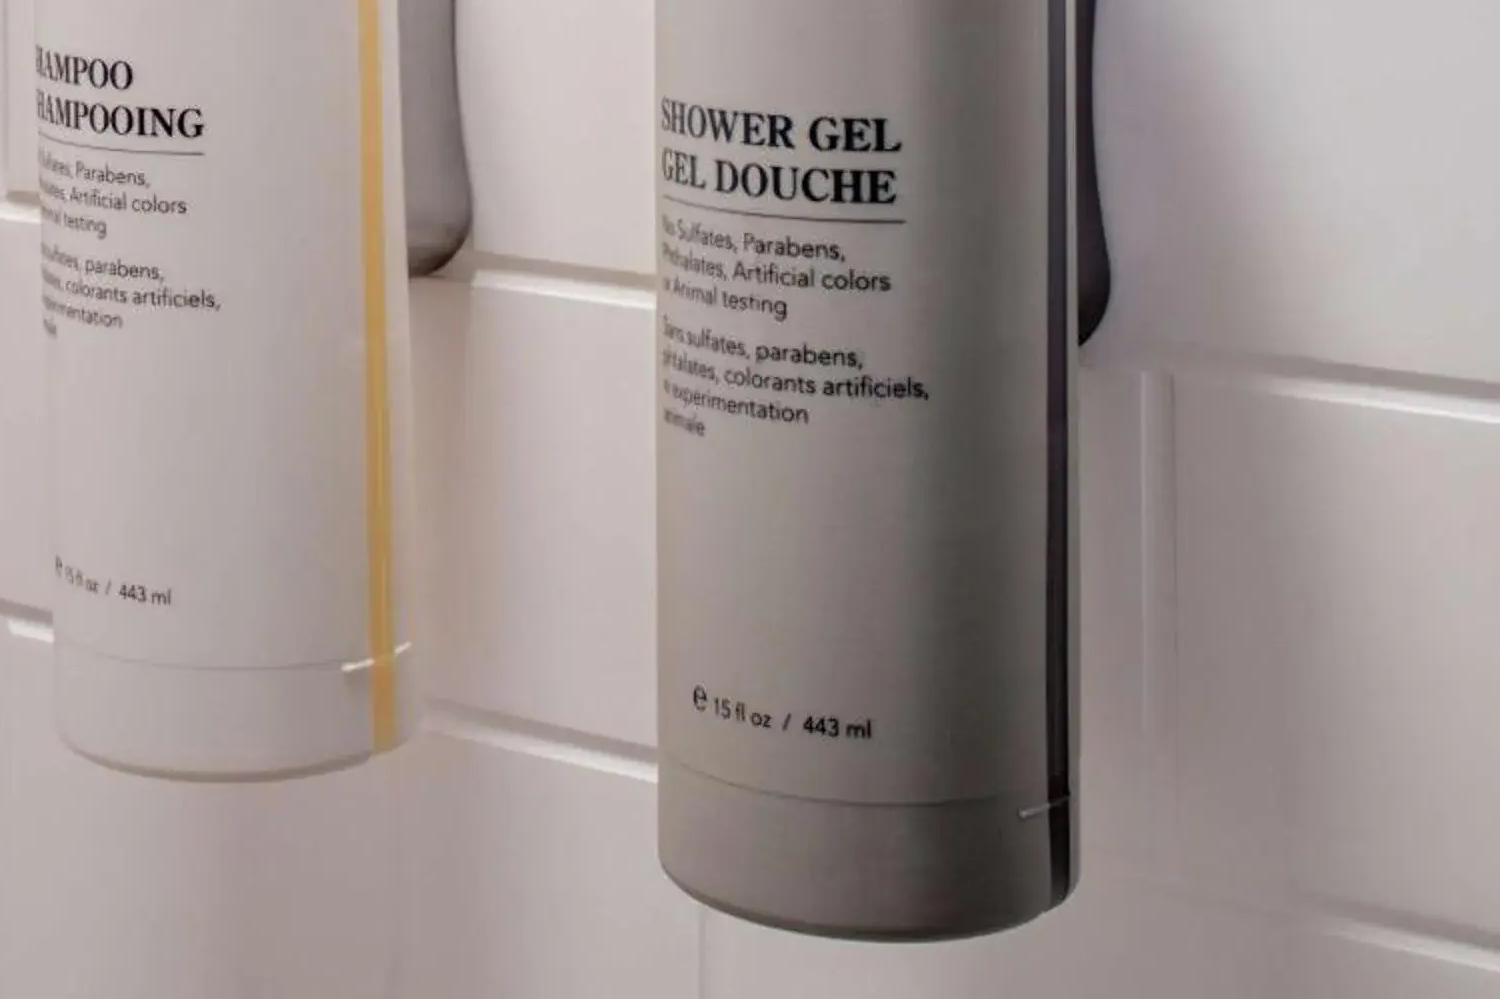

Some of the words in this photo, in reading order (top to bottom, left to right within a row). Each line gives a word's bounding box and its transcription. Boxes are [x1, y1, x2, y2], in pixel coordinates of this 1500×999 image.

[35, 45, 134, 90] HAMPOO
[36, 88, 205, 138] HAMPOOING
[661, 96, 796, 150] SHOWER
[808, 116, 902, 152] GEL
[75, 160, 151, 188] Parabens,
[661, 147, 707, 190] GEL
[714, 158, 897, 204] DOUCHE
[70, 187, 127, 211] Artificial
[132, 194, 187, 214] colors
[64, 212, 107, 240] testing
[678, 218, 737, 252] Sulfates,
[743, 232, 845, 262] Parabens,
[85, 258, 165, 283] parabens,
[732, 261, 814, 289] Artificial
[821, 269, 892, 292] colors
[65, 278, 127, 304] colorants
[132, 286, 221, 312] artificiels,
[673, 277, 717, 306] Animal
[722, 291, 788, 322] testing
[687, 329, 750, 359] sulfates,
[755, 343, 863, 371] parabens,
[724, 368, 816, 394] colorants
[823, 375, 929, 401] artificiels,
[119, 584, 147, 603] 443
[151, 588, 171, 605] ml
[714, 697, 730, 720] 15
[751, 713, 773, 729] oz
[803, 715, 839, 738] 443
[846, 719, 872, 740] ml
